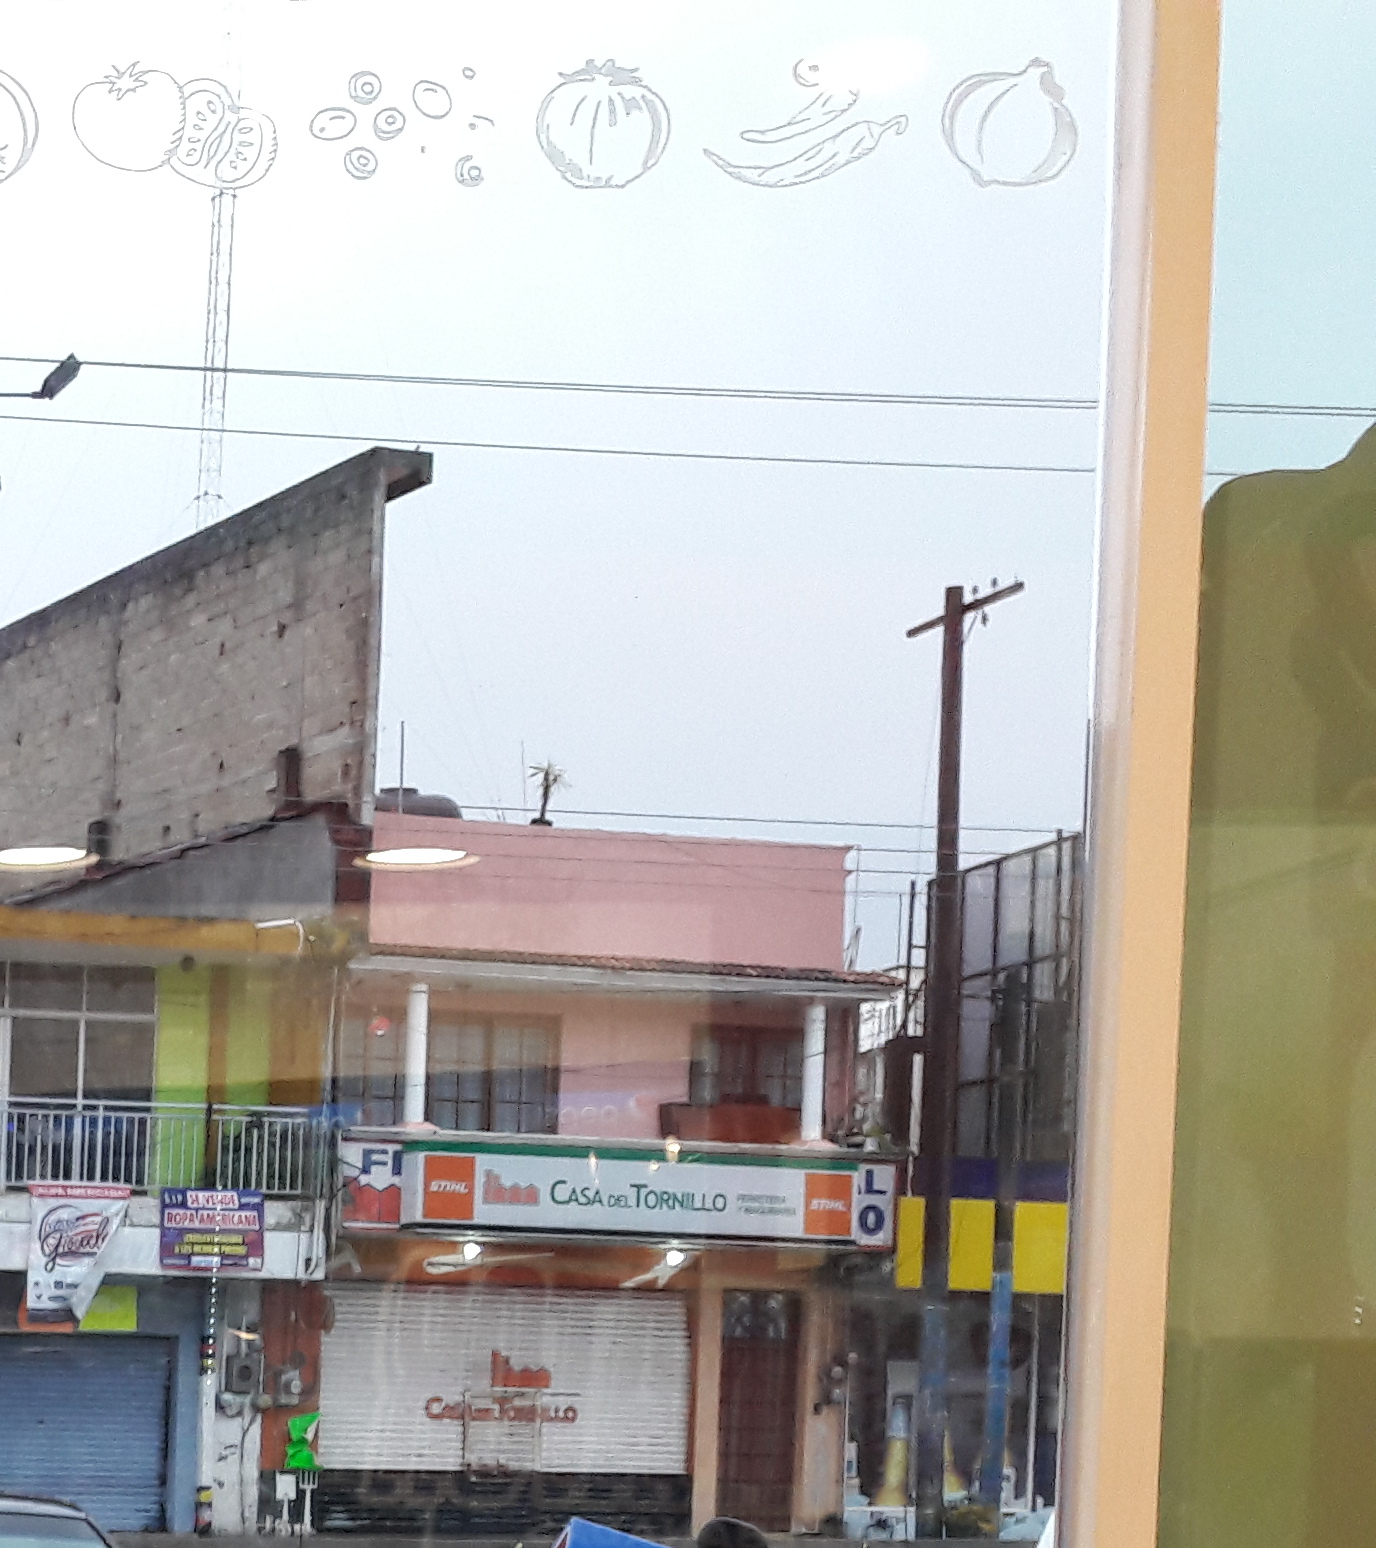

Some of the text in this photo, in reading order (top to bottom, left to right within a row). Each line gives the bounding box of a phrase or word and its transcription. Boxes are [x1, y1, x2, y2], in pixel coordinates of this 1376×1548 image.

[429, 1180, 469, 1194] STIHL
[550, 1180, 605, 1206] CASA
[630, 1183, 727, 1212] TORNILLO
[166, 1211, 258, 1227] ROPA AMERICANA
